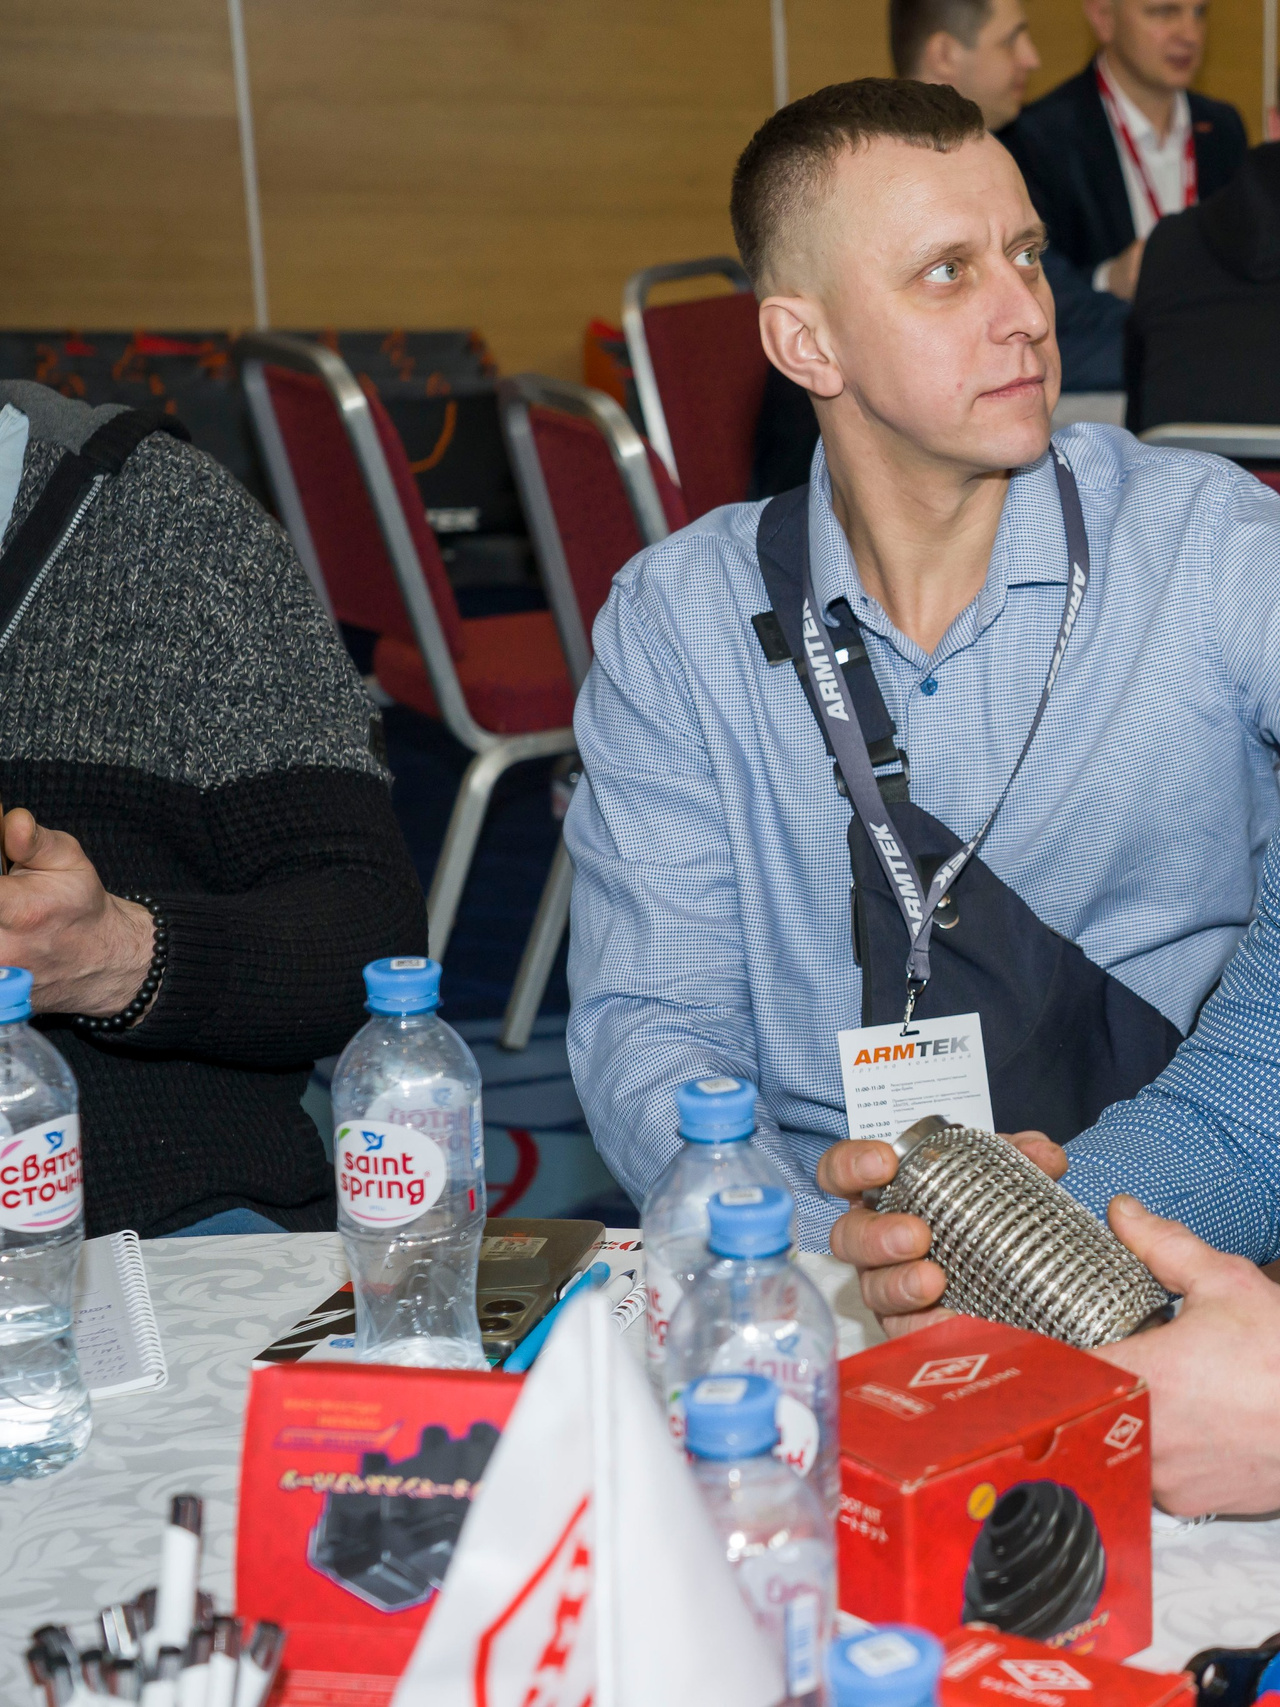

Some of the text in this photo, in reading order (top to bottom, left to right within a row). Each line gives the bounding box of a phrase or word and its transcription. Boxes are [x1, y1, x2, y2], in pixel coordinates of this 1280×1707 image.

[1046, 562, 1087, 694] ARMTEK
[853, 1035, 971, 1066] ARMTEK
[344, 1152, 413, 1175] saint
[341, 1173, 425, 1205] spring
